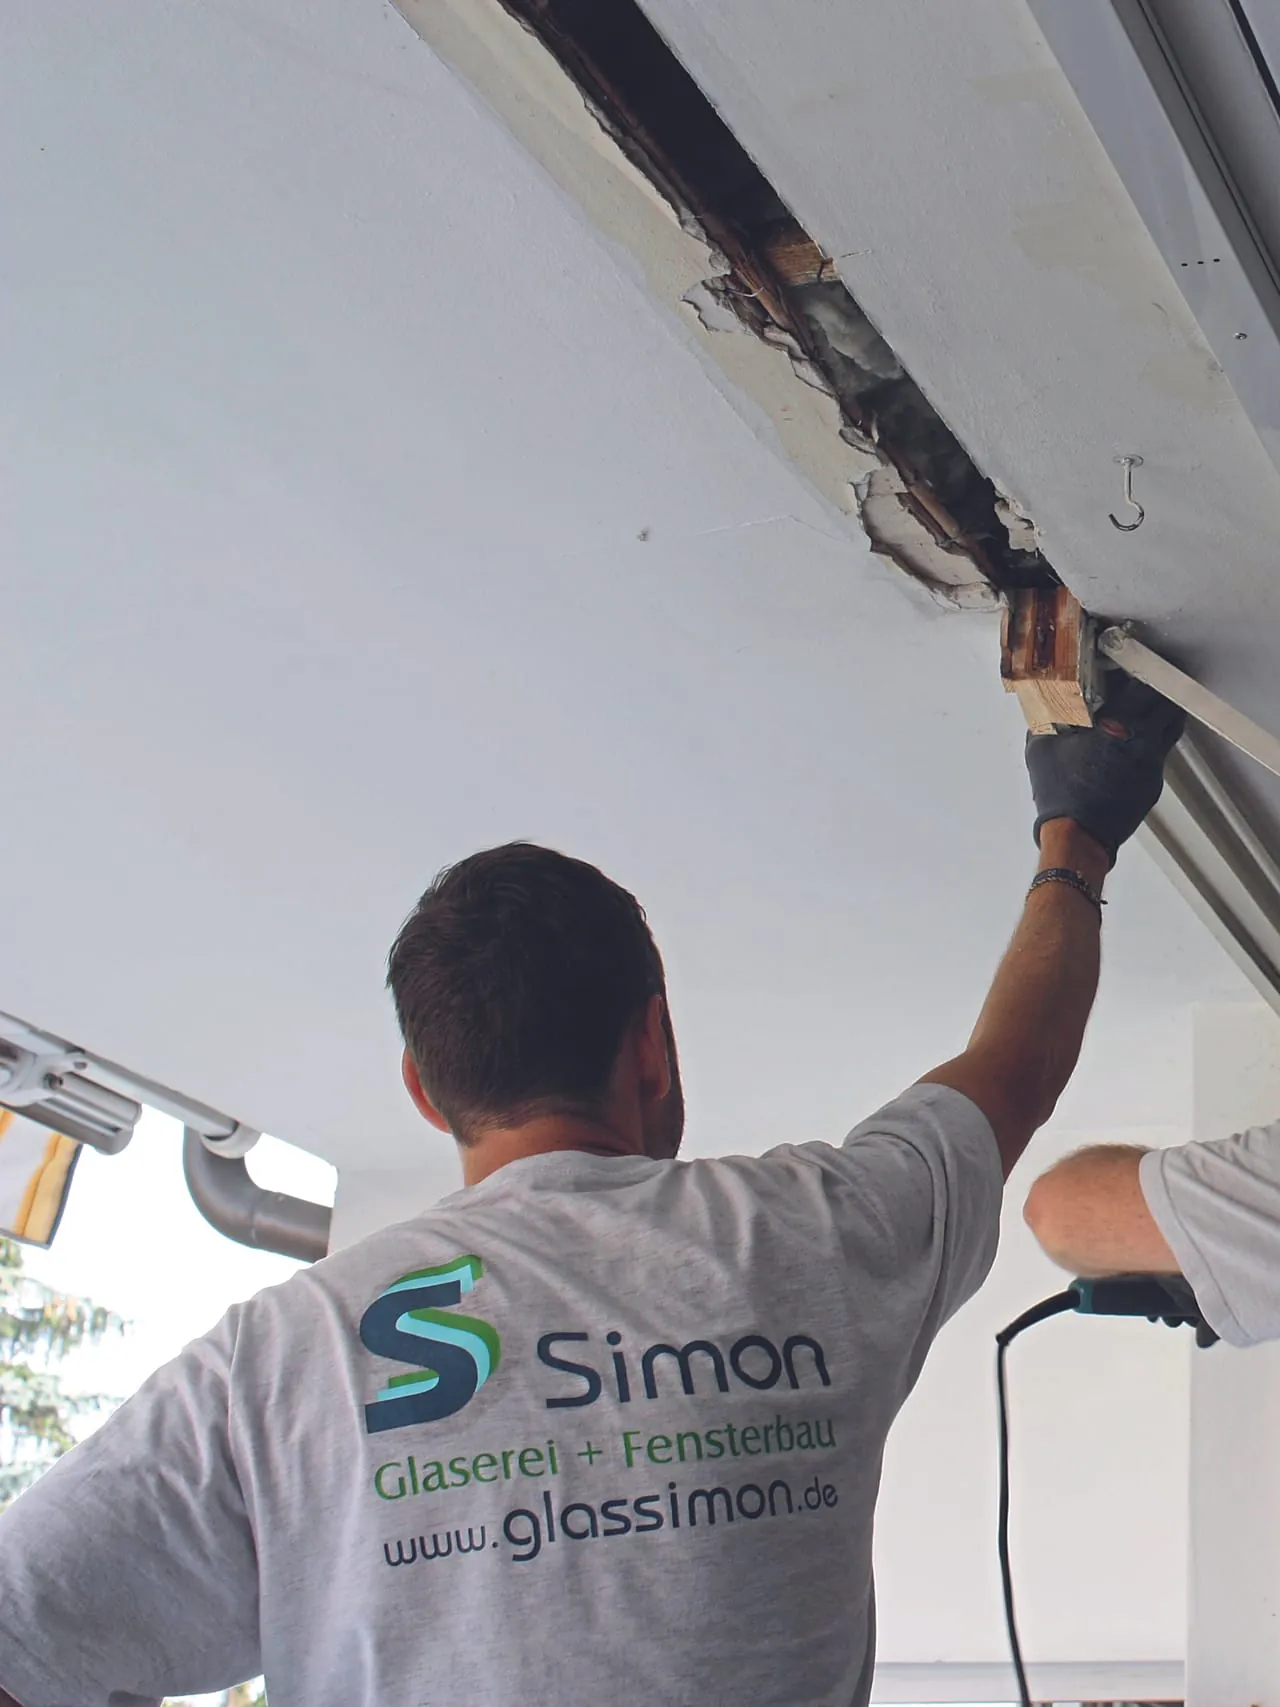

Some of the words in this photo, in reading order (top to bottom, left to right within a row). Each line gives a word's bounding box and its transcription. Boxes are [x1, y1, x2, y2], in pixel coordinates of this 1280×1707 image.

[537, 1331, 831, 1408] Simon
[374, 1438, 559, 1501] Glaserei
[577, 1440, 603, 1467] +
[622, 1414, 837, 1468] Fensterbau
[383, 1475, 840, 1566] www.glassimon.de
